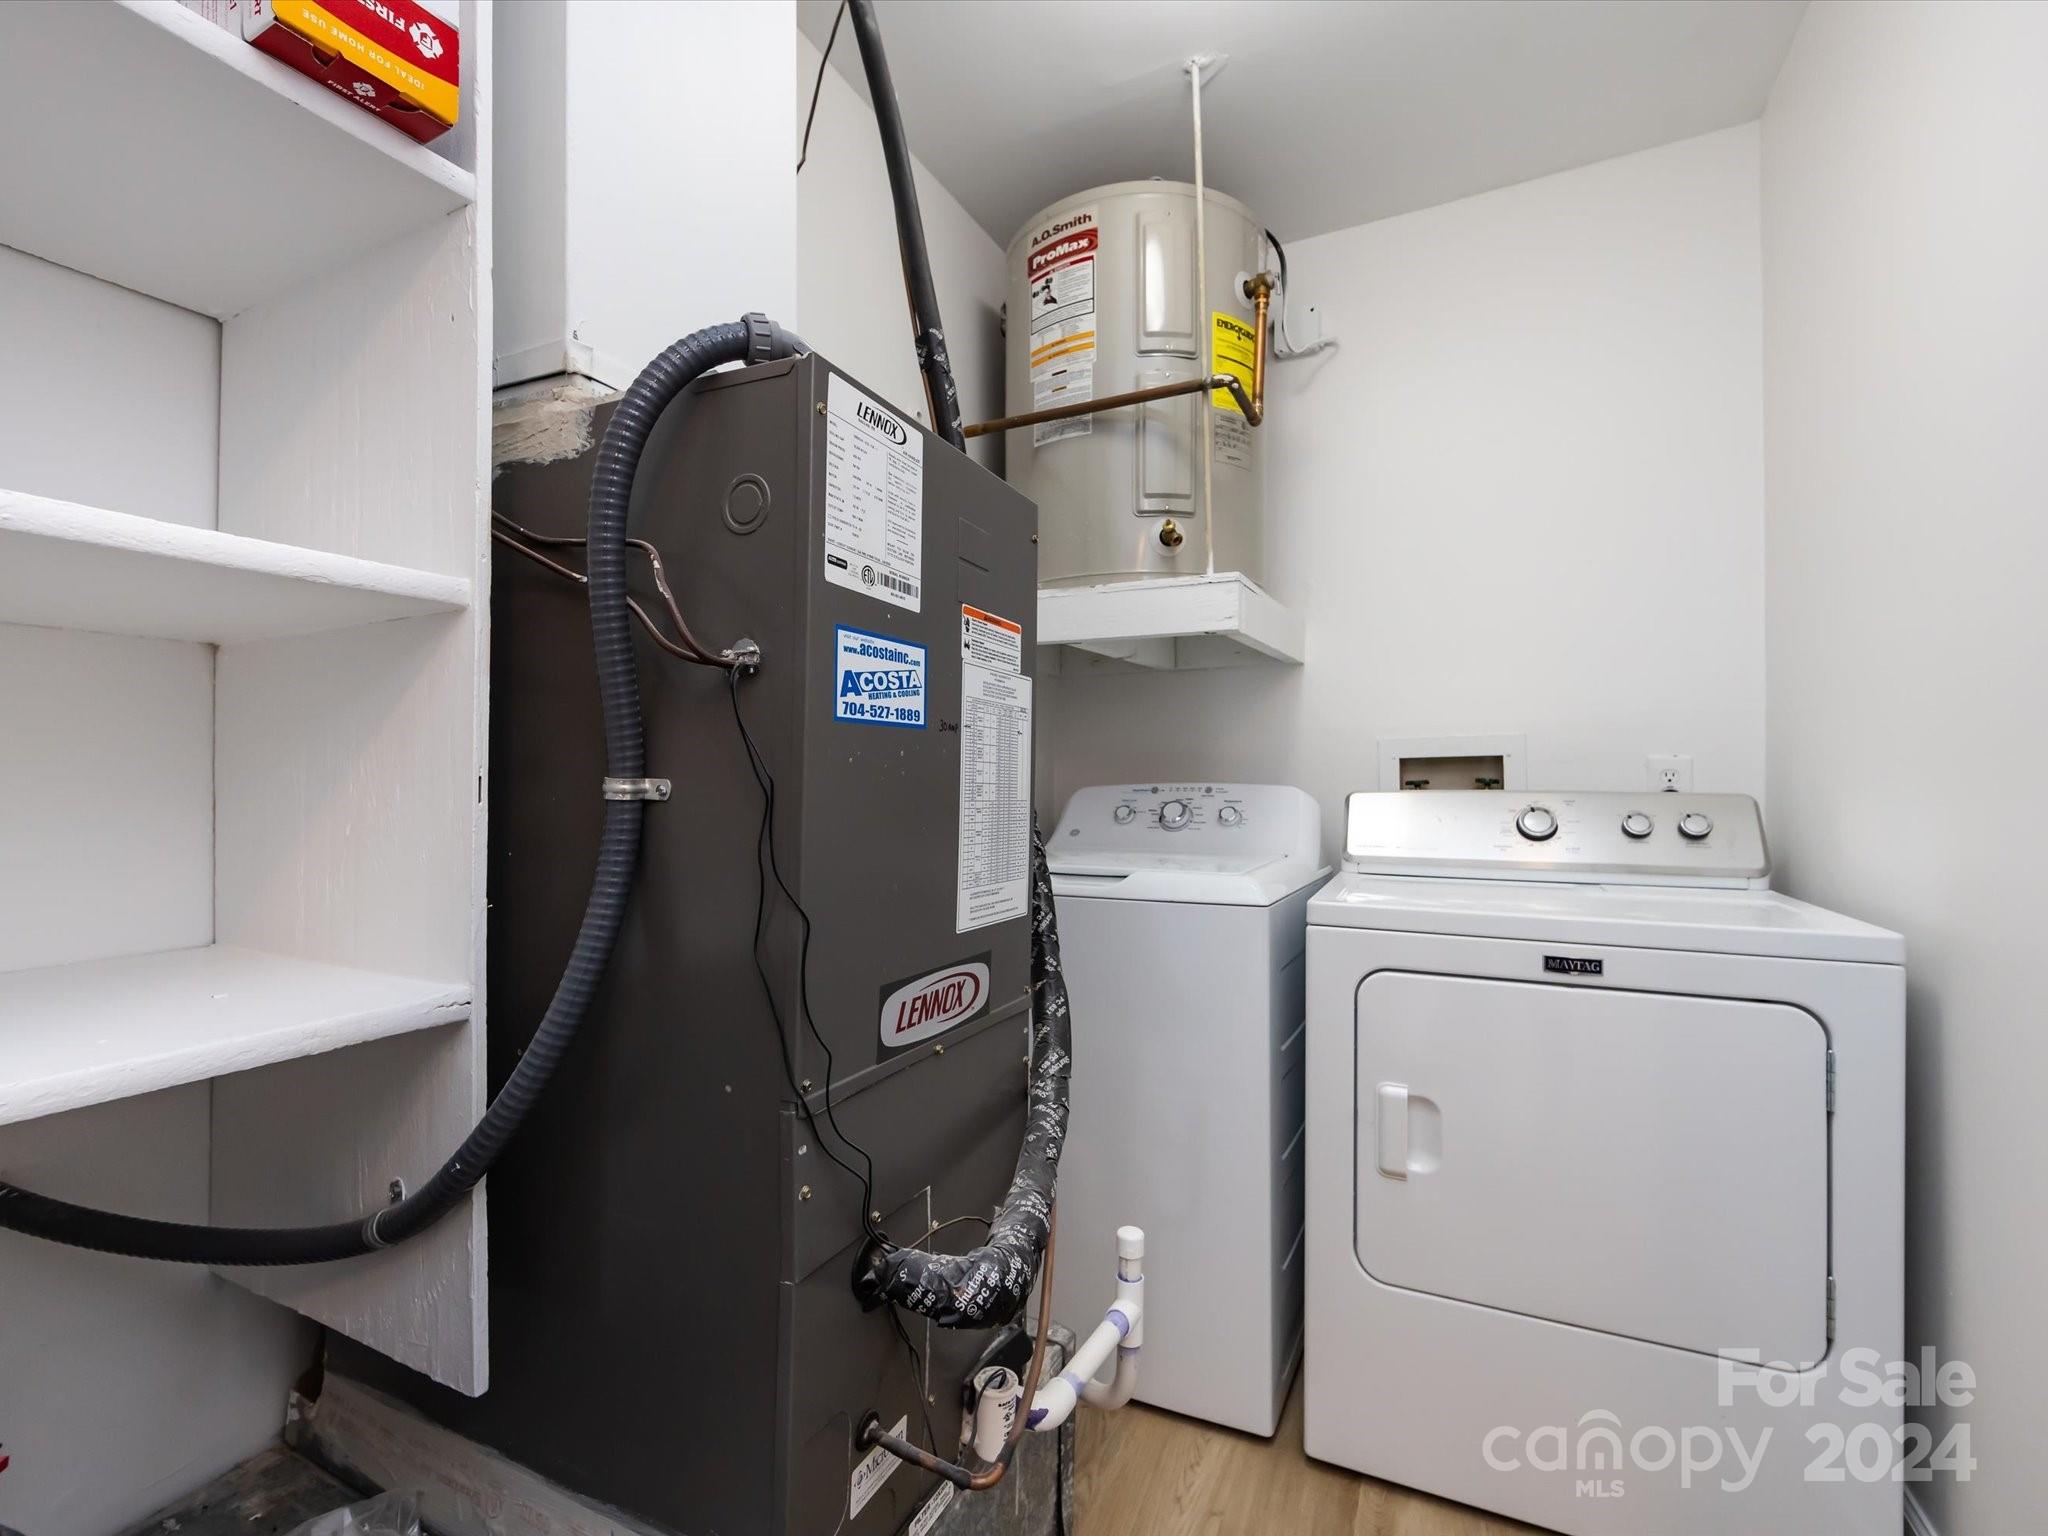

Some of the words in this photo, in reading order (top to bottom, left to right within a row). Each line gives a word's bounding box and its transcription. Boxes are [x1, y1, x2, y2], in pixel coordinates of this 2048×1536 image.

[303, 7, 327, 30] USE
[331, 27, 365, 53] HOME
[368, 50, 392, 69] FOR
[395, 66, 425, 90] IDEAL
[1032, 237, 1090, 270] ProMax
[856, 401, 899, 440] LENNOX
[843, 643, 921, 668] www.acostainc.com
[840, 669, 921, 698] ACOSTA
[868, 692, 892, 700] HEATING
[897, 689, 920, 698] COOLING
[842, 701, 920, 723] 704-527-1889
[1547, 958, 1600, 972] MAYTAG
[895, 978, 967, 1035] LENNOX
[954, 1262, 988, 1312] Shurtape
[976, 1287, 990, 1306] PC
